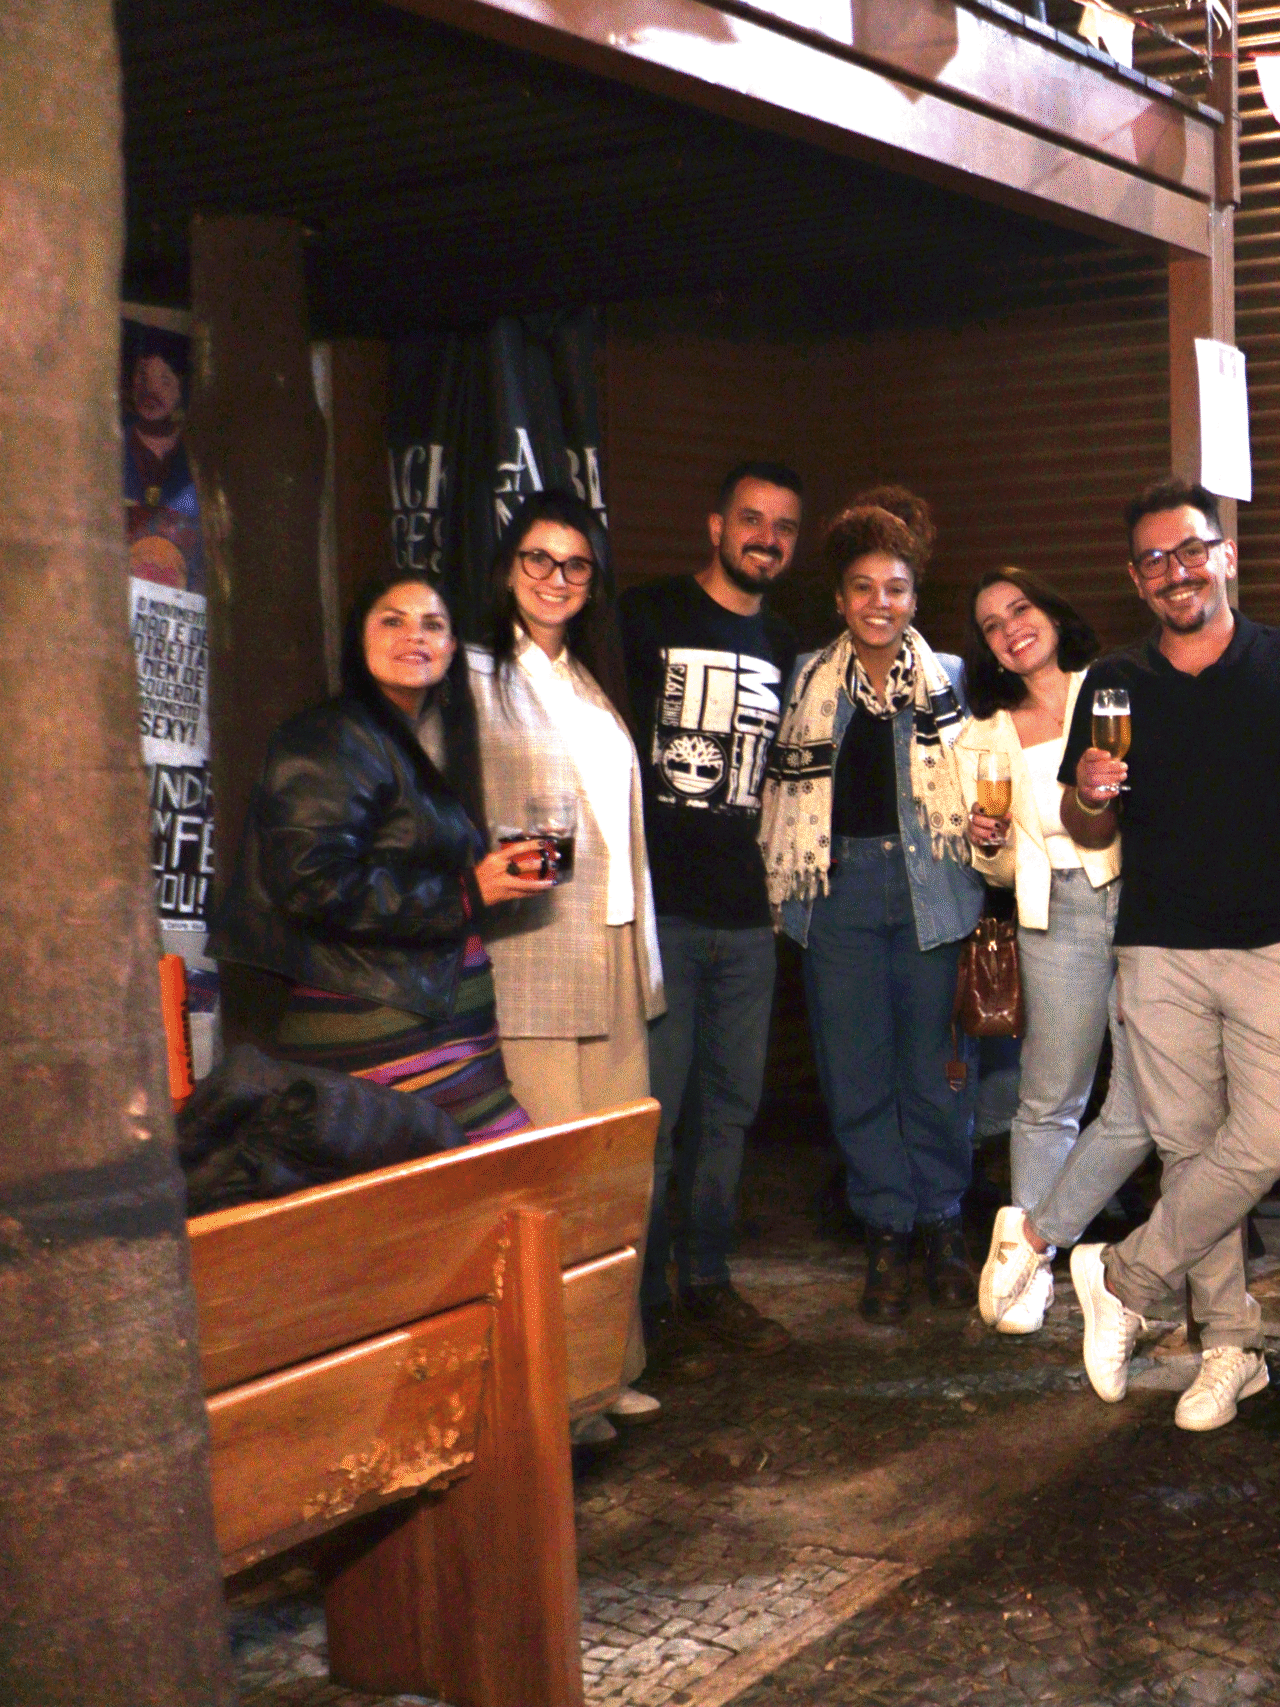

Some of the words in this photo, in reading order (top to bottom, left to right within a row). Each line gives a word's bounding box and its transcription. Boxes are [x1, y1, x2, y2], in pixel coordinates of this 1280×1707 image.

[664, 663, 687, 699] 1973
[139, 711, 198, 747] SEXY!
[661, 699, 682, 727] SINCE
[155, 873, 208, 915] OU!
